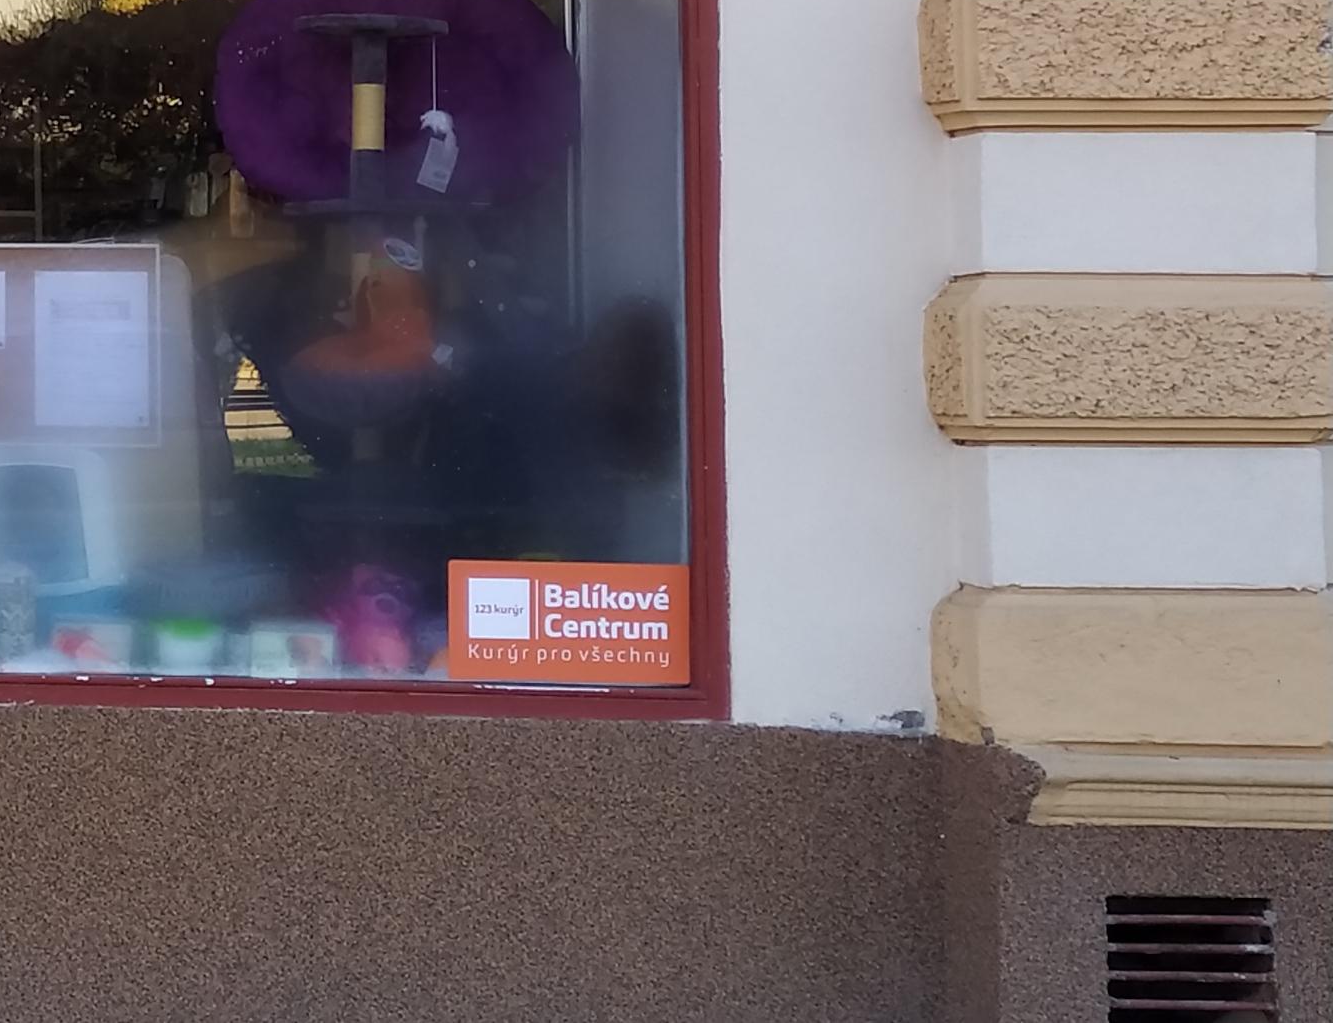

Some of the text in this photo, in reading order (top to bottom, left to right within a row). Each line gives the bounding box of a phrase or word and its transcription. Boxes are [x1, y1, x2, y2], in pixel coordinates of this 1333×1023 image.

[544, 583, 670, 610] Balíkové
[475, 604, 524, 617] 123 kurýr
[544, 614, 669, 640] Centrum
[468, 643, 670, 668] Kurýr pro všechny
